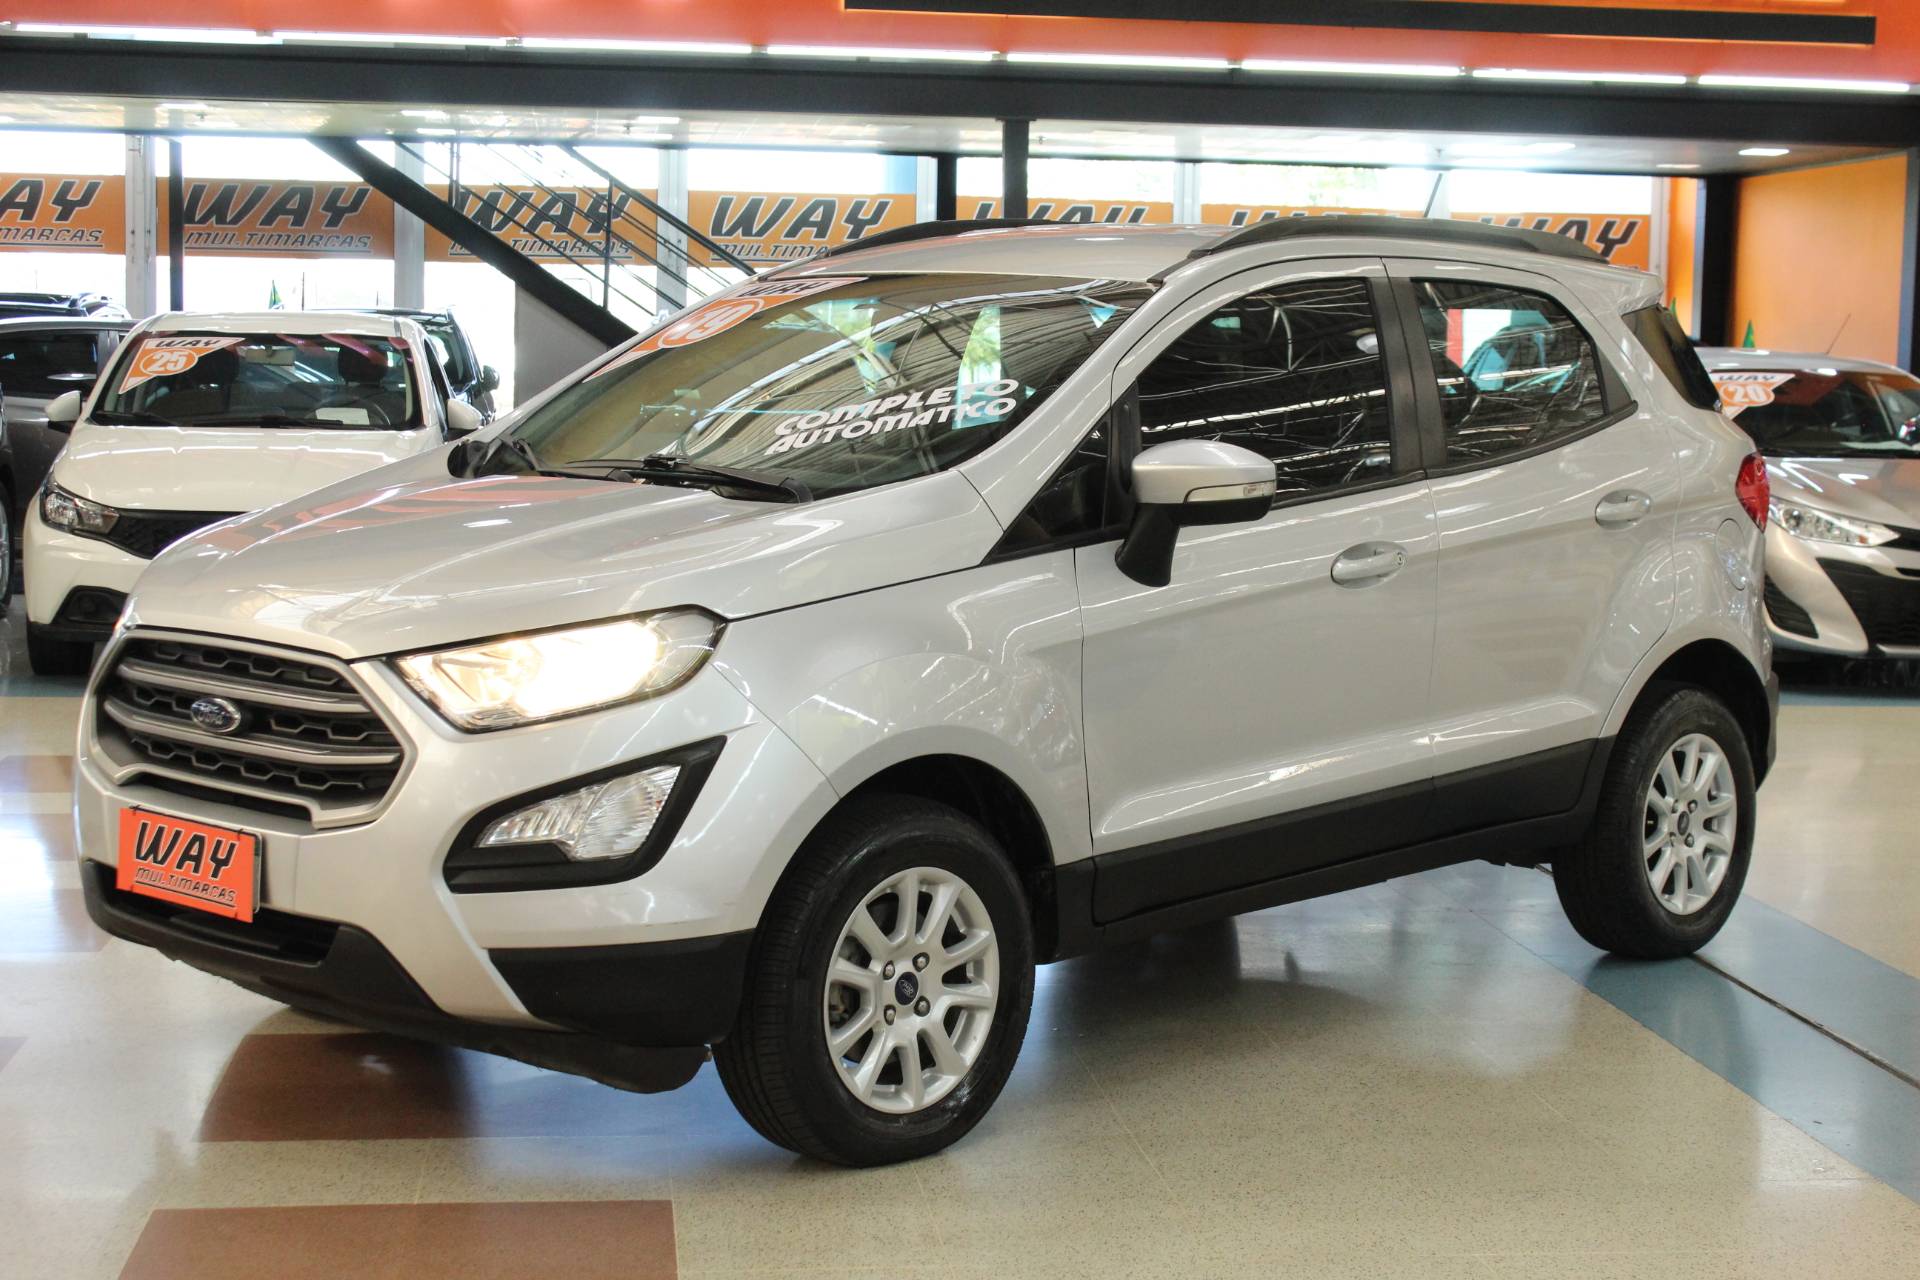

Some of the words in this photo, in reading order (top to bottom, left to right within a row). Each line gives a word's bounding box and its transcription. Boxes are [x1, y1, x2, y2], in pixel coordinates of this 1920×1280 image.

[0, 178, 104, 223] AY
[182, 183, 373, 229] WAY
[710, 195, 893, 241] WAY
[0, 227, 104, 242] MARCAS
[183, 231, 372, 249] MULTIMARCAS
[1480, 217, 1643, 261] AY
[145, 350, 190, 372] 25
[156, 339, 221, 348] WAY
[764, 397, 1017, 456] AUTOMATICO
[775, 378, 1020, 436] COMPLETO
[134, 820, 238, 881] WAY
[135, 866, 237, 903] MULTIMARCAS
